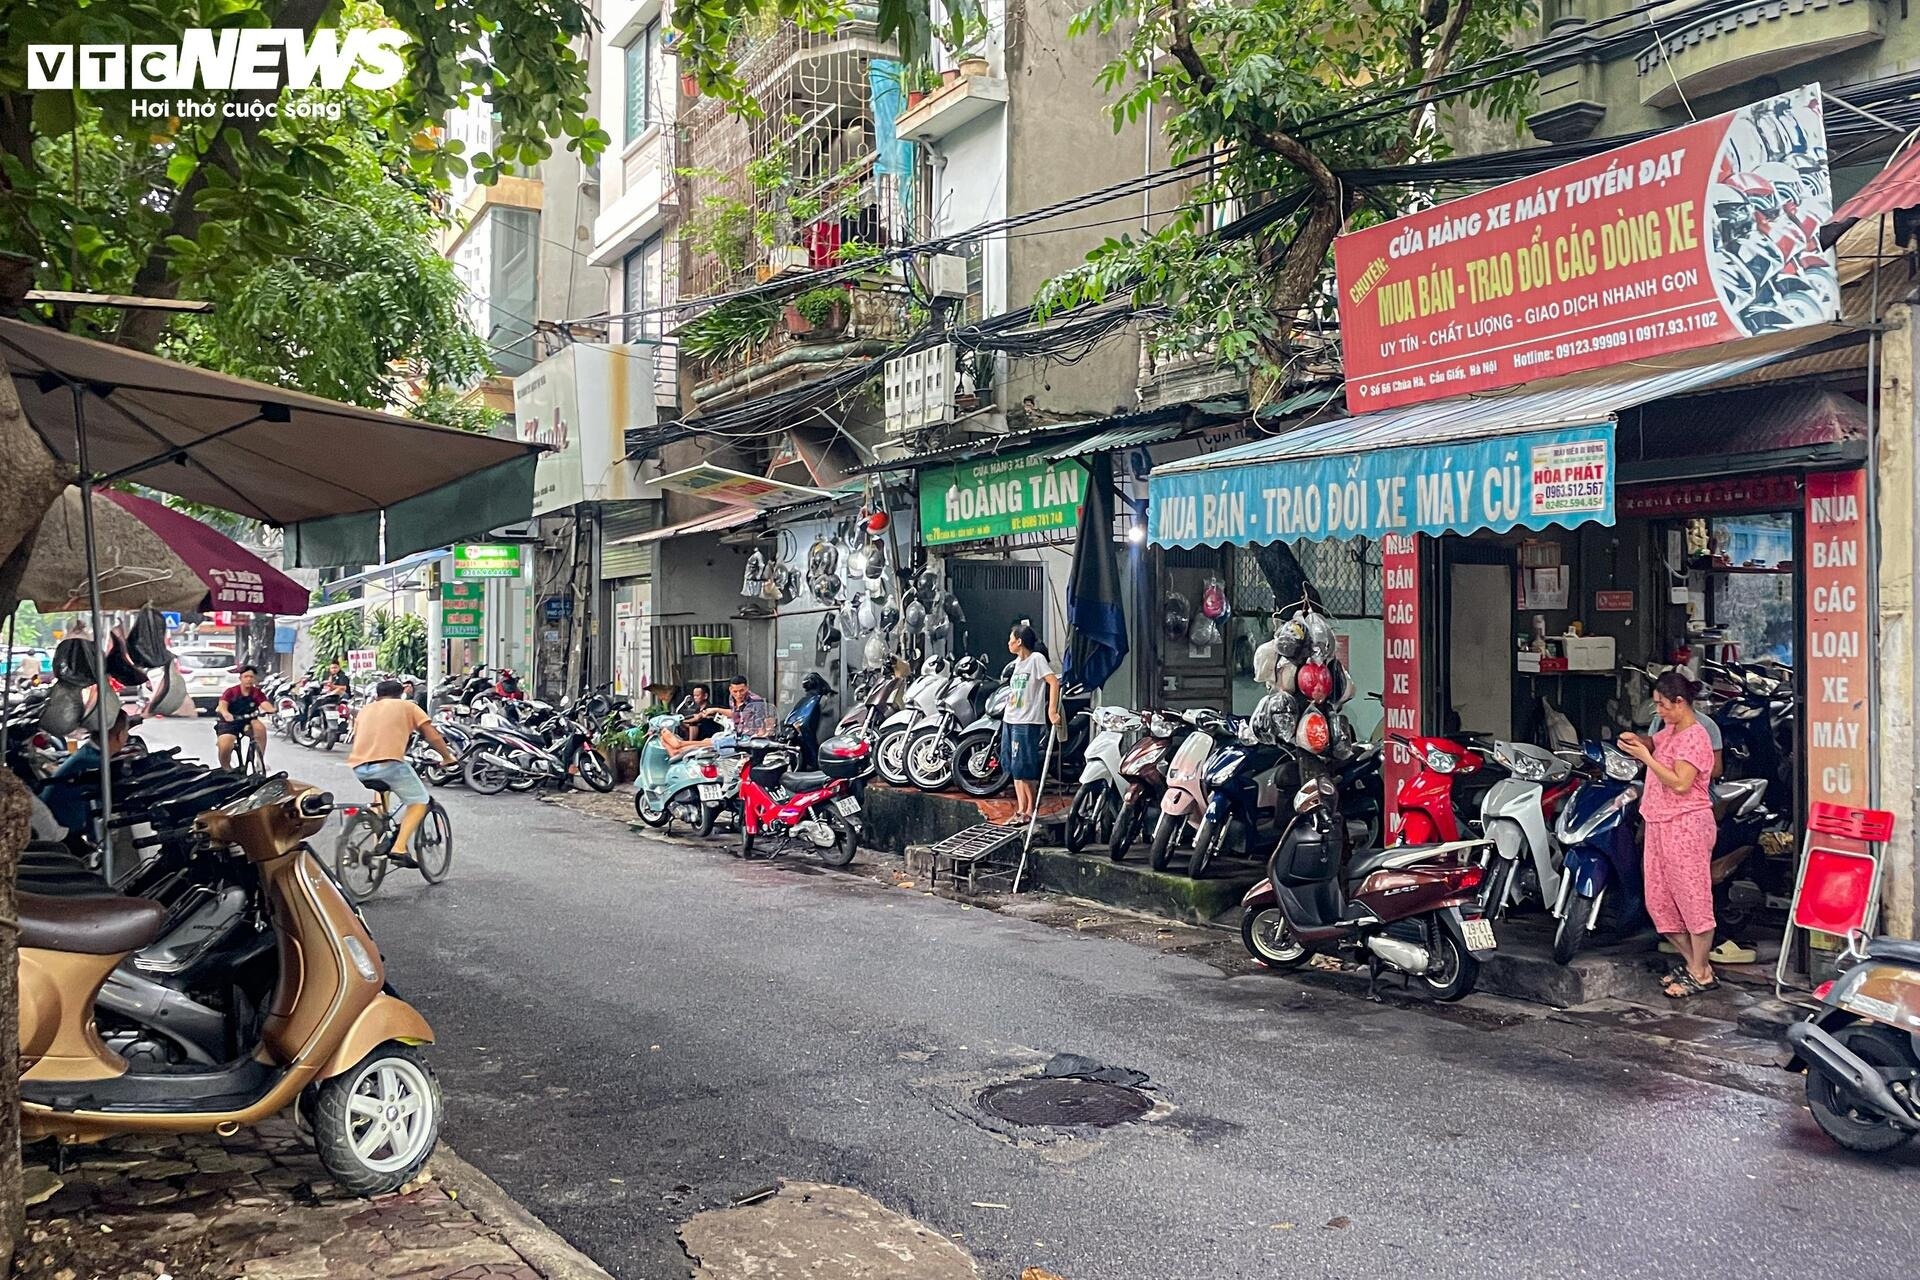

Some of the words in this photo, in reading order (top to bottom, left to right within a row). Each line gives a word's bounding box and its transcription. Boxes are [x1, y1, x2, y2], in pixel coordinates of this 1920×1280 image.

[1389, 226, 1424, 259] CỬA
[1427, 216, 1482, 249] HÀNG
[1485, 203, 1511, 231] XE
[1514, 186, 1561, 223] MÁY
[1565, 158, 1634, 208] TUYẾN
[1638, 149, 1686, 187] ĐẠT
[1378, 279, 1416, 327] MUA
[1417, 262, 1456, 317] BÁN
[1466, 252, 1514, 304] TRAO
[1518, 224, 1552, 292] ĐỔI
[1555, 223, 1597, 282] CÁC
[1601, 208, 1662, 270] DÒNG
[1665, 200, 1698, 254] XE
[1349, 257, 1389, 304] CHUYÊN:
[1380, 341, 1396, 357] UY
[1399, 333, 1419, 352] TÍN
[1429, 320, 1463, 347] CHẤT
[1467, 313, 1513, 339] LƯỢNG
[1525, 303, 1560, 325] GIAO
[1563, 292, 1598, 317] DỊCH
[1603, 279, 1657, 306] NHANH
[1661, 268, 1698, 293] GỌN
[1513, 350, 1554, 368] Hotline:
[1556, 330, 1627, 359] 09123.99909
[1636, 311, 1718, 342] 0917.93.1102
[1470, 364, 1481, 376] Hà
[1482, 361, 1498, 375] Nội
[1534, 466, 1561, 485] HÒA
[1565, 462, 1604, 481] PHÁT
[945, 480, 1023, 522] HOÀNG
[1029, 466, 1079, 509] TÂN
[1159, 496, 1197, 540] MUA
[1203, 480, 1245, 538] BÁN
[1262, 483, 1321, 535] TRAO
[1328, 457, 1367, 531] ĐỔI
[1375, 476, 1407, 529] XE
[1416, 457, 1475, 527] MÁY
[1483, 451, 1520, 522] CŨ
[1545, 482, 1604, 499] 0963.512.567
[1811, 496, 1858, 523] MUA
[1813, 536, 1857, 569] BÁN
[1386, 563, 1414, 590] BÁN
[1813, 581, 1857, 613] CÁC
[1388, 599, 1414, 625] CÁC
[1386, 639, 1415, 664] LOẠI
[1812, 631, 1859, 663] LOẠI
[1392, 673, 1409, 695] XE
[1822, 676, 1849, 703] XE
[1387, 703, 1415, 730] MÁY
[1813, 721, 1860, 749] MÁY
[1822, 766, 1851, 794] CŨ
